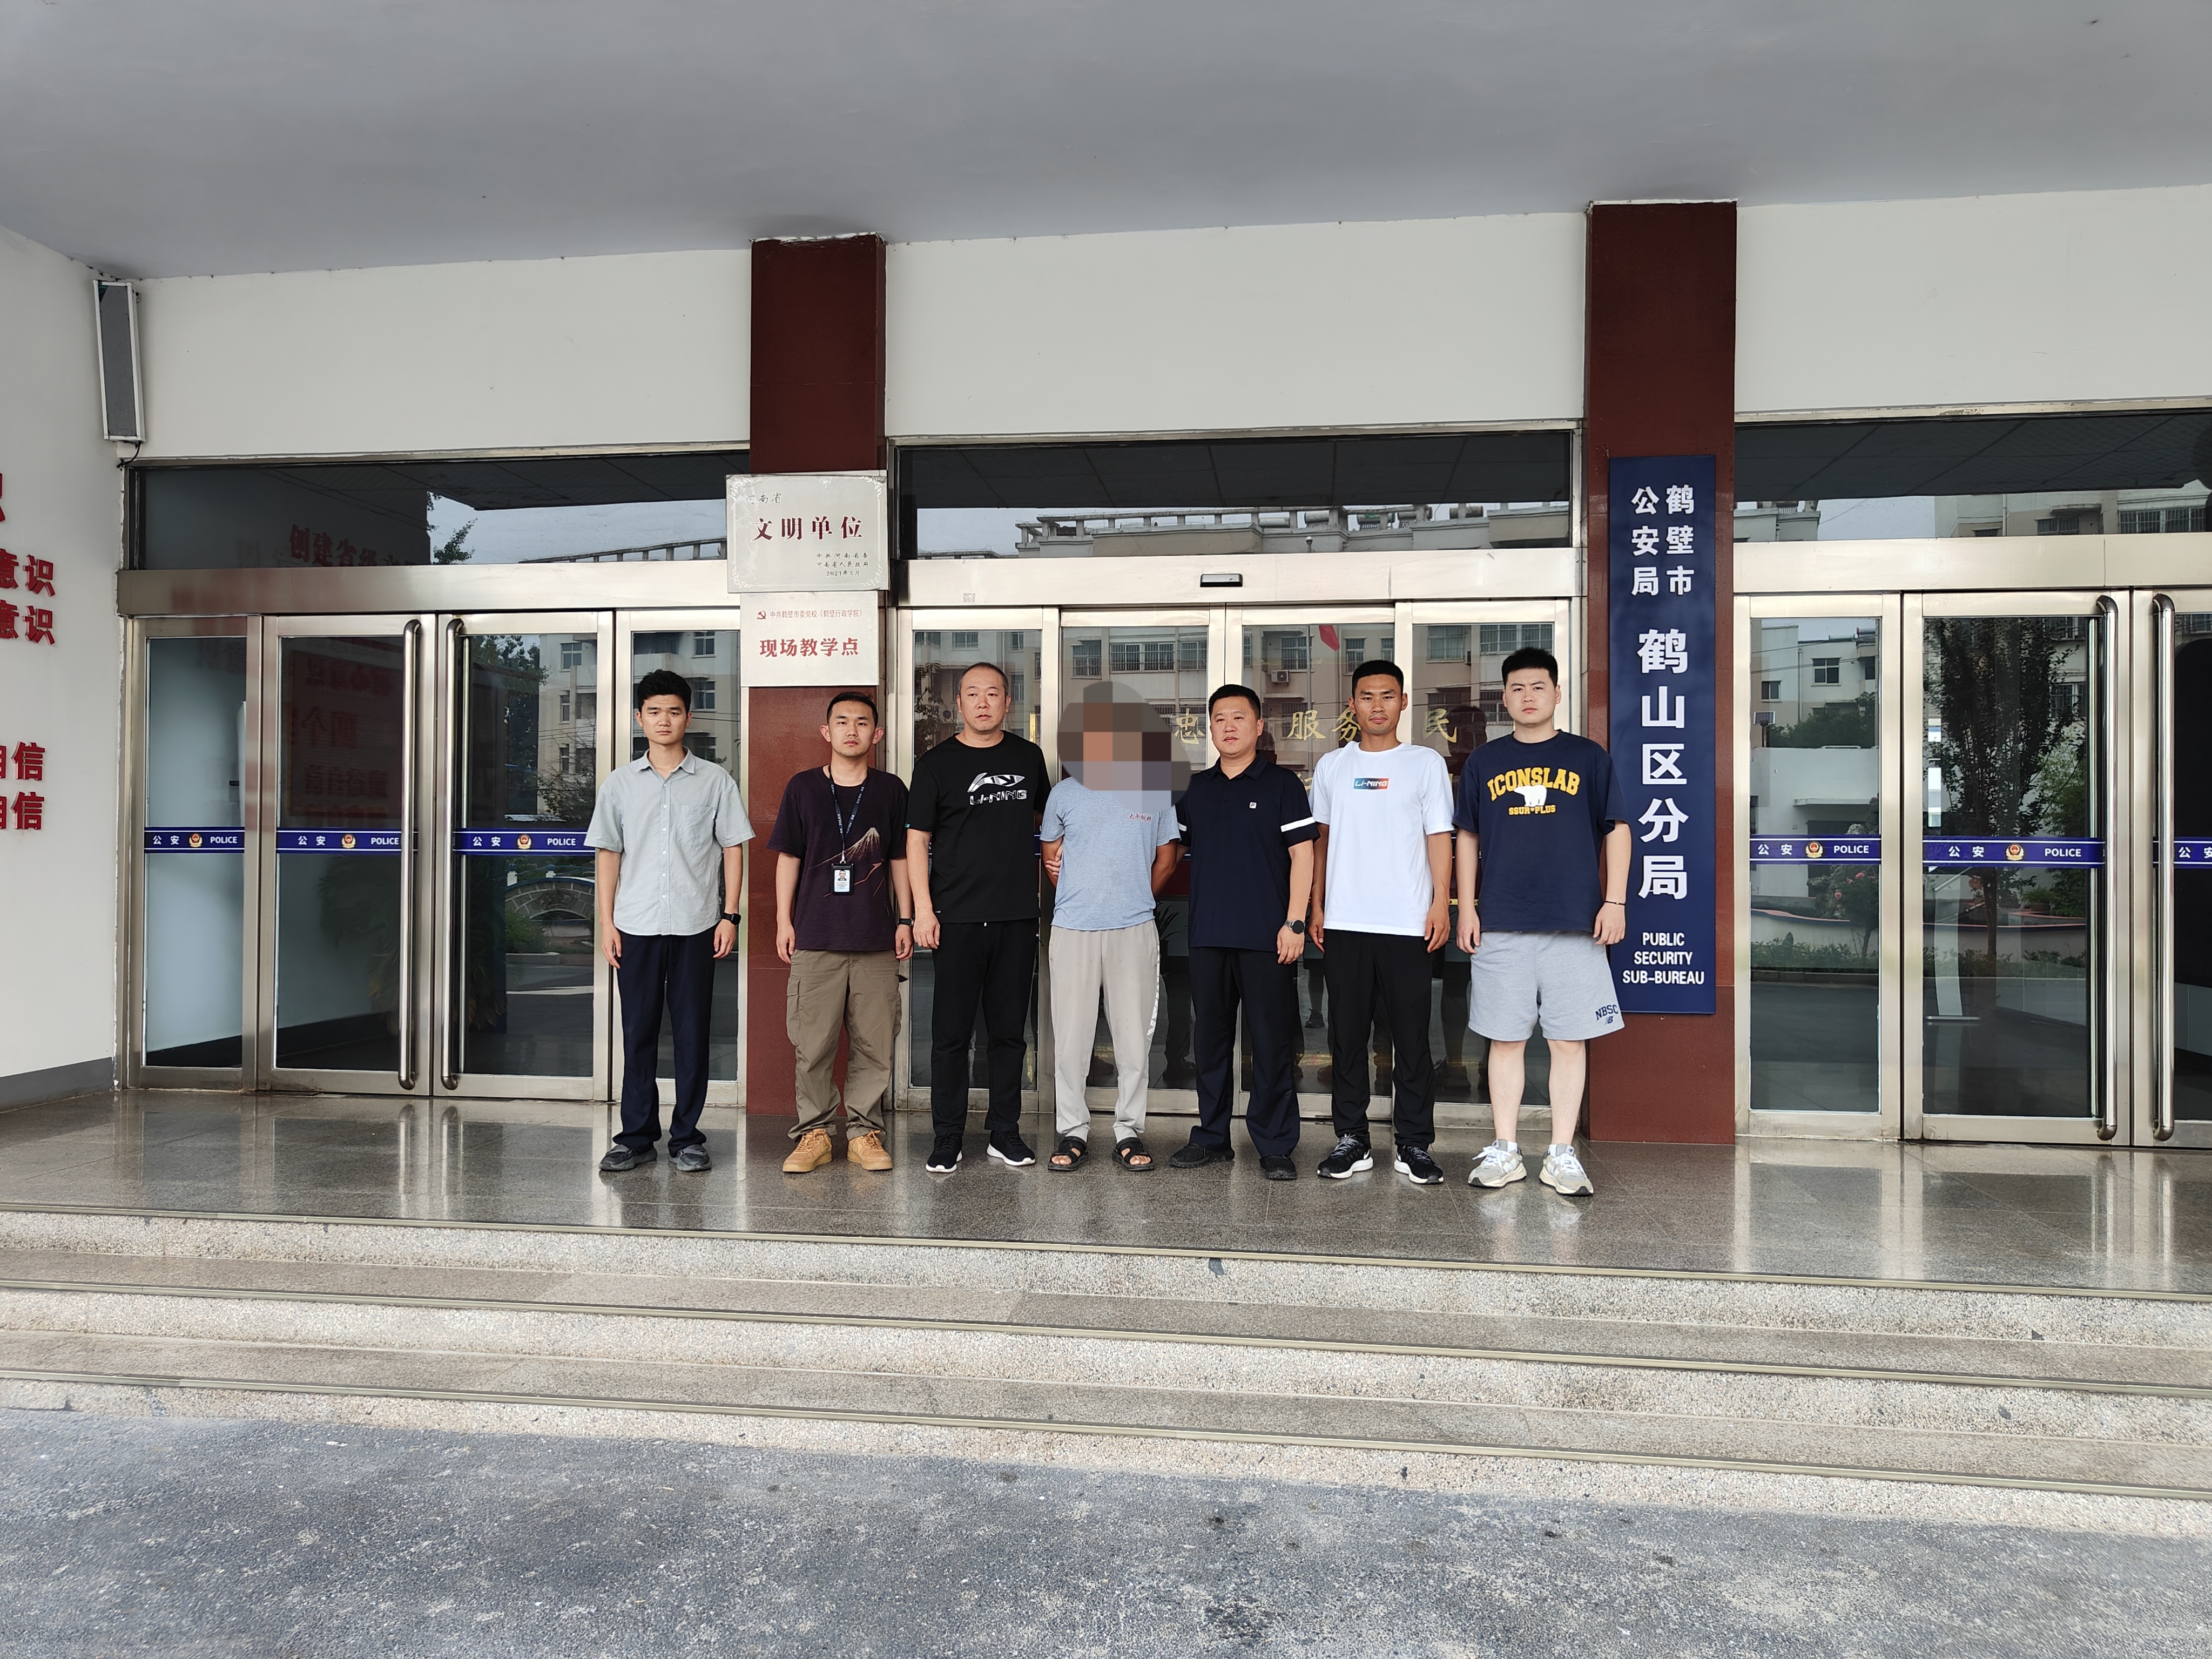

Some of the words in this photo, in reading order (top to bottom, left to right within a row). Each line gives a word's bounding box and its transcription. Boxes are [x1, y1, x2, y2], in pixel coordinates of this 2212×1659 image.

[746, 492, 781, 504] 河南省
[751, 516, 863, 541] 文明单位
[1630, 486, 1660, 596] 公安局
[1665, 484, 1695, 595] 鹤壁市
[816, 552, 869, 561] 中共河南省委
[816, 561, 869, 569] 河南省人民政府
[759, 638, 859, 657] 现场教学点
[0, 740, 45, 781] 信
[1636, 628, 1689, 900] 鹤山区分局
[1354, 779, 1388, 789] LI-NING
[1487, 767, 1580, 801] ICONSLAB
[970, 790, 1027, 805] LI-NING
[0, 791, 45, 830] 信
[152, 835, 180, 845] 公安
[210, 836, 238, 844] POLICE
[298, 835, 326, 846] 公安
[370, 837, 399, 845] POLICE
[472, 836, 501, 847] 公安
[547, 838, 576, 846] POLICE
[1758, 844, 1792, 855] 公安
[1833, 845, 1870, 854] POLICE
[1948, 846, 1985, 858] 公安
[2045, 847, 2082, 858] POLICE
[1642, 932, 1685, 946] PUBLIC
[1634, 951, 1692, 965] SECURITY
[1622, 970, 1704, 984] SUB-BUREAU
[1595, 1004, 1618, 1021] NBSC
